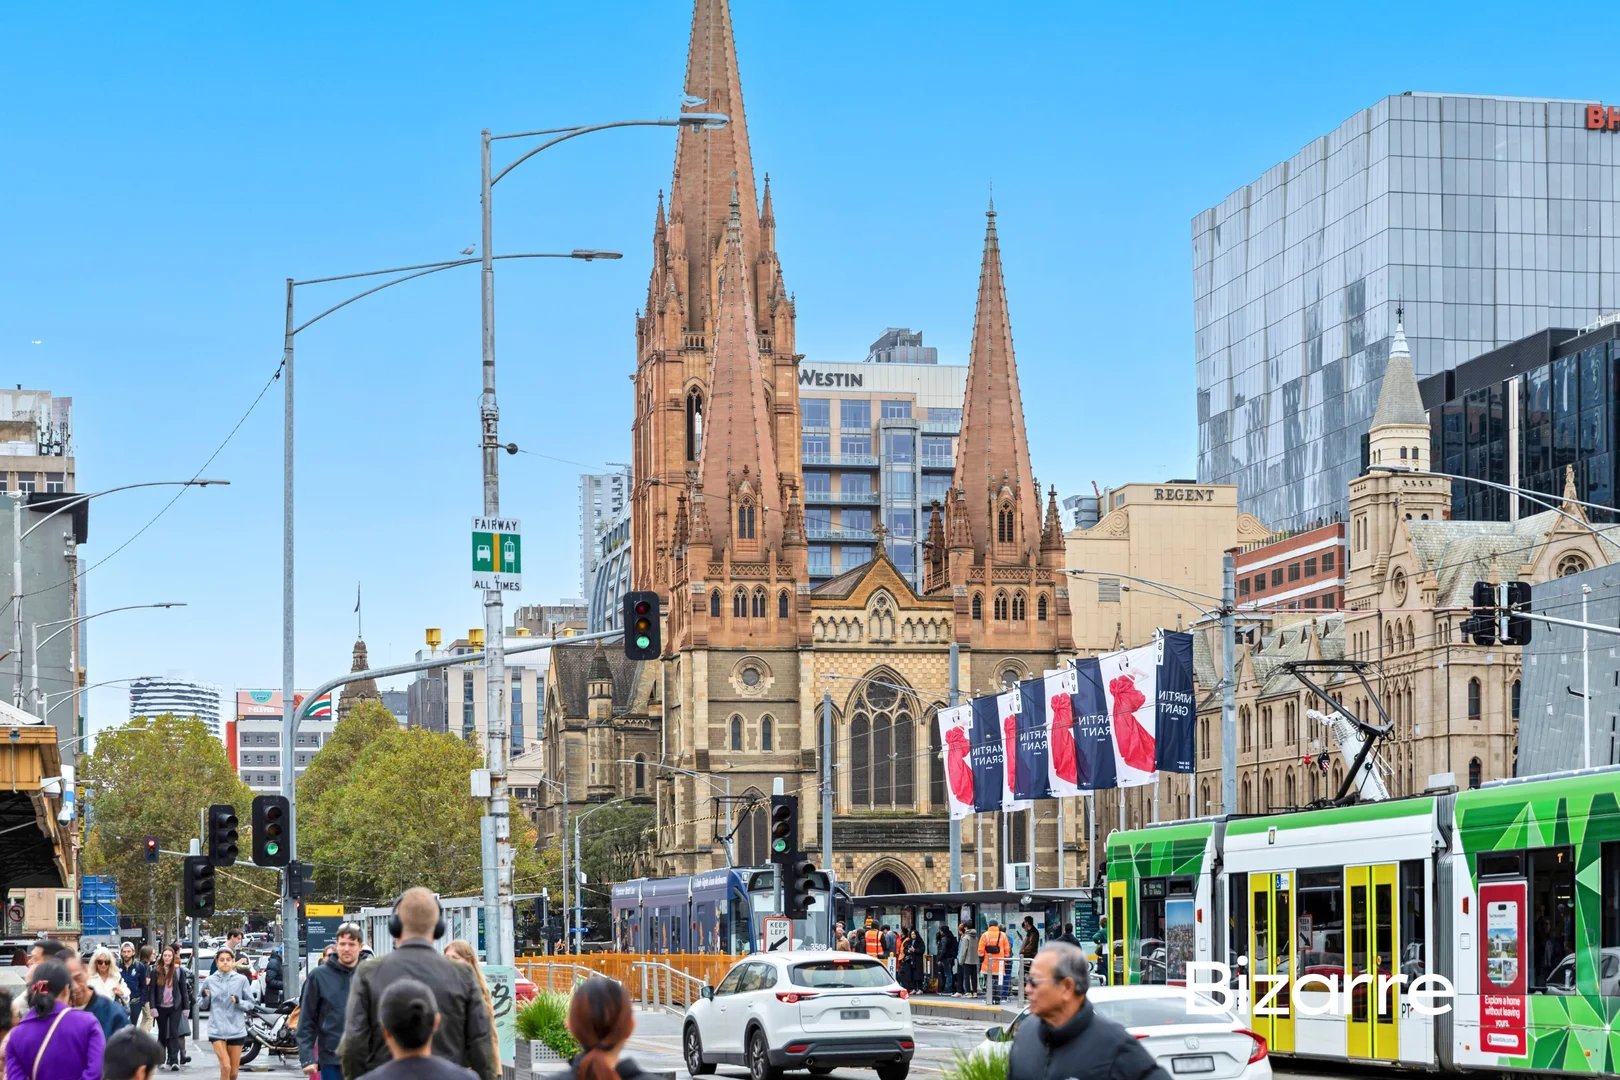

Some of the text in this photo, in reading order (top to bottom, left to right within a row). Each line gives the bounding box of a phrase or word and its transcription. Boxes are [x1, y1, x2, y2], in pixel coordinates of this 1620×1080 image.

[1154, 488, 1215, 502] REGENT
[474, 518, 517, 531] FAIRWAY
[474, 580, 520, 591] ALL TIMES
[1484, 995, 1502, 1006] Explore
[1506, 996, 1520, 1006] home
[1484, 1006, 1520, 1019] without leaving
